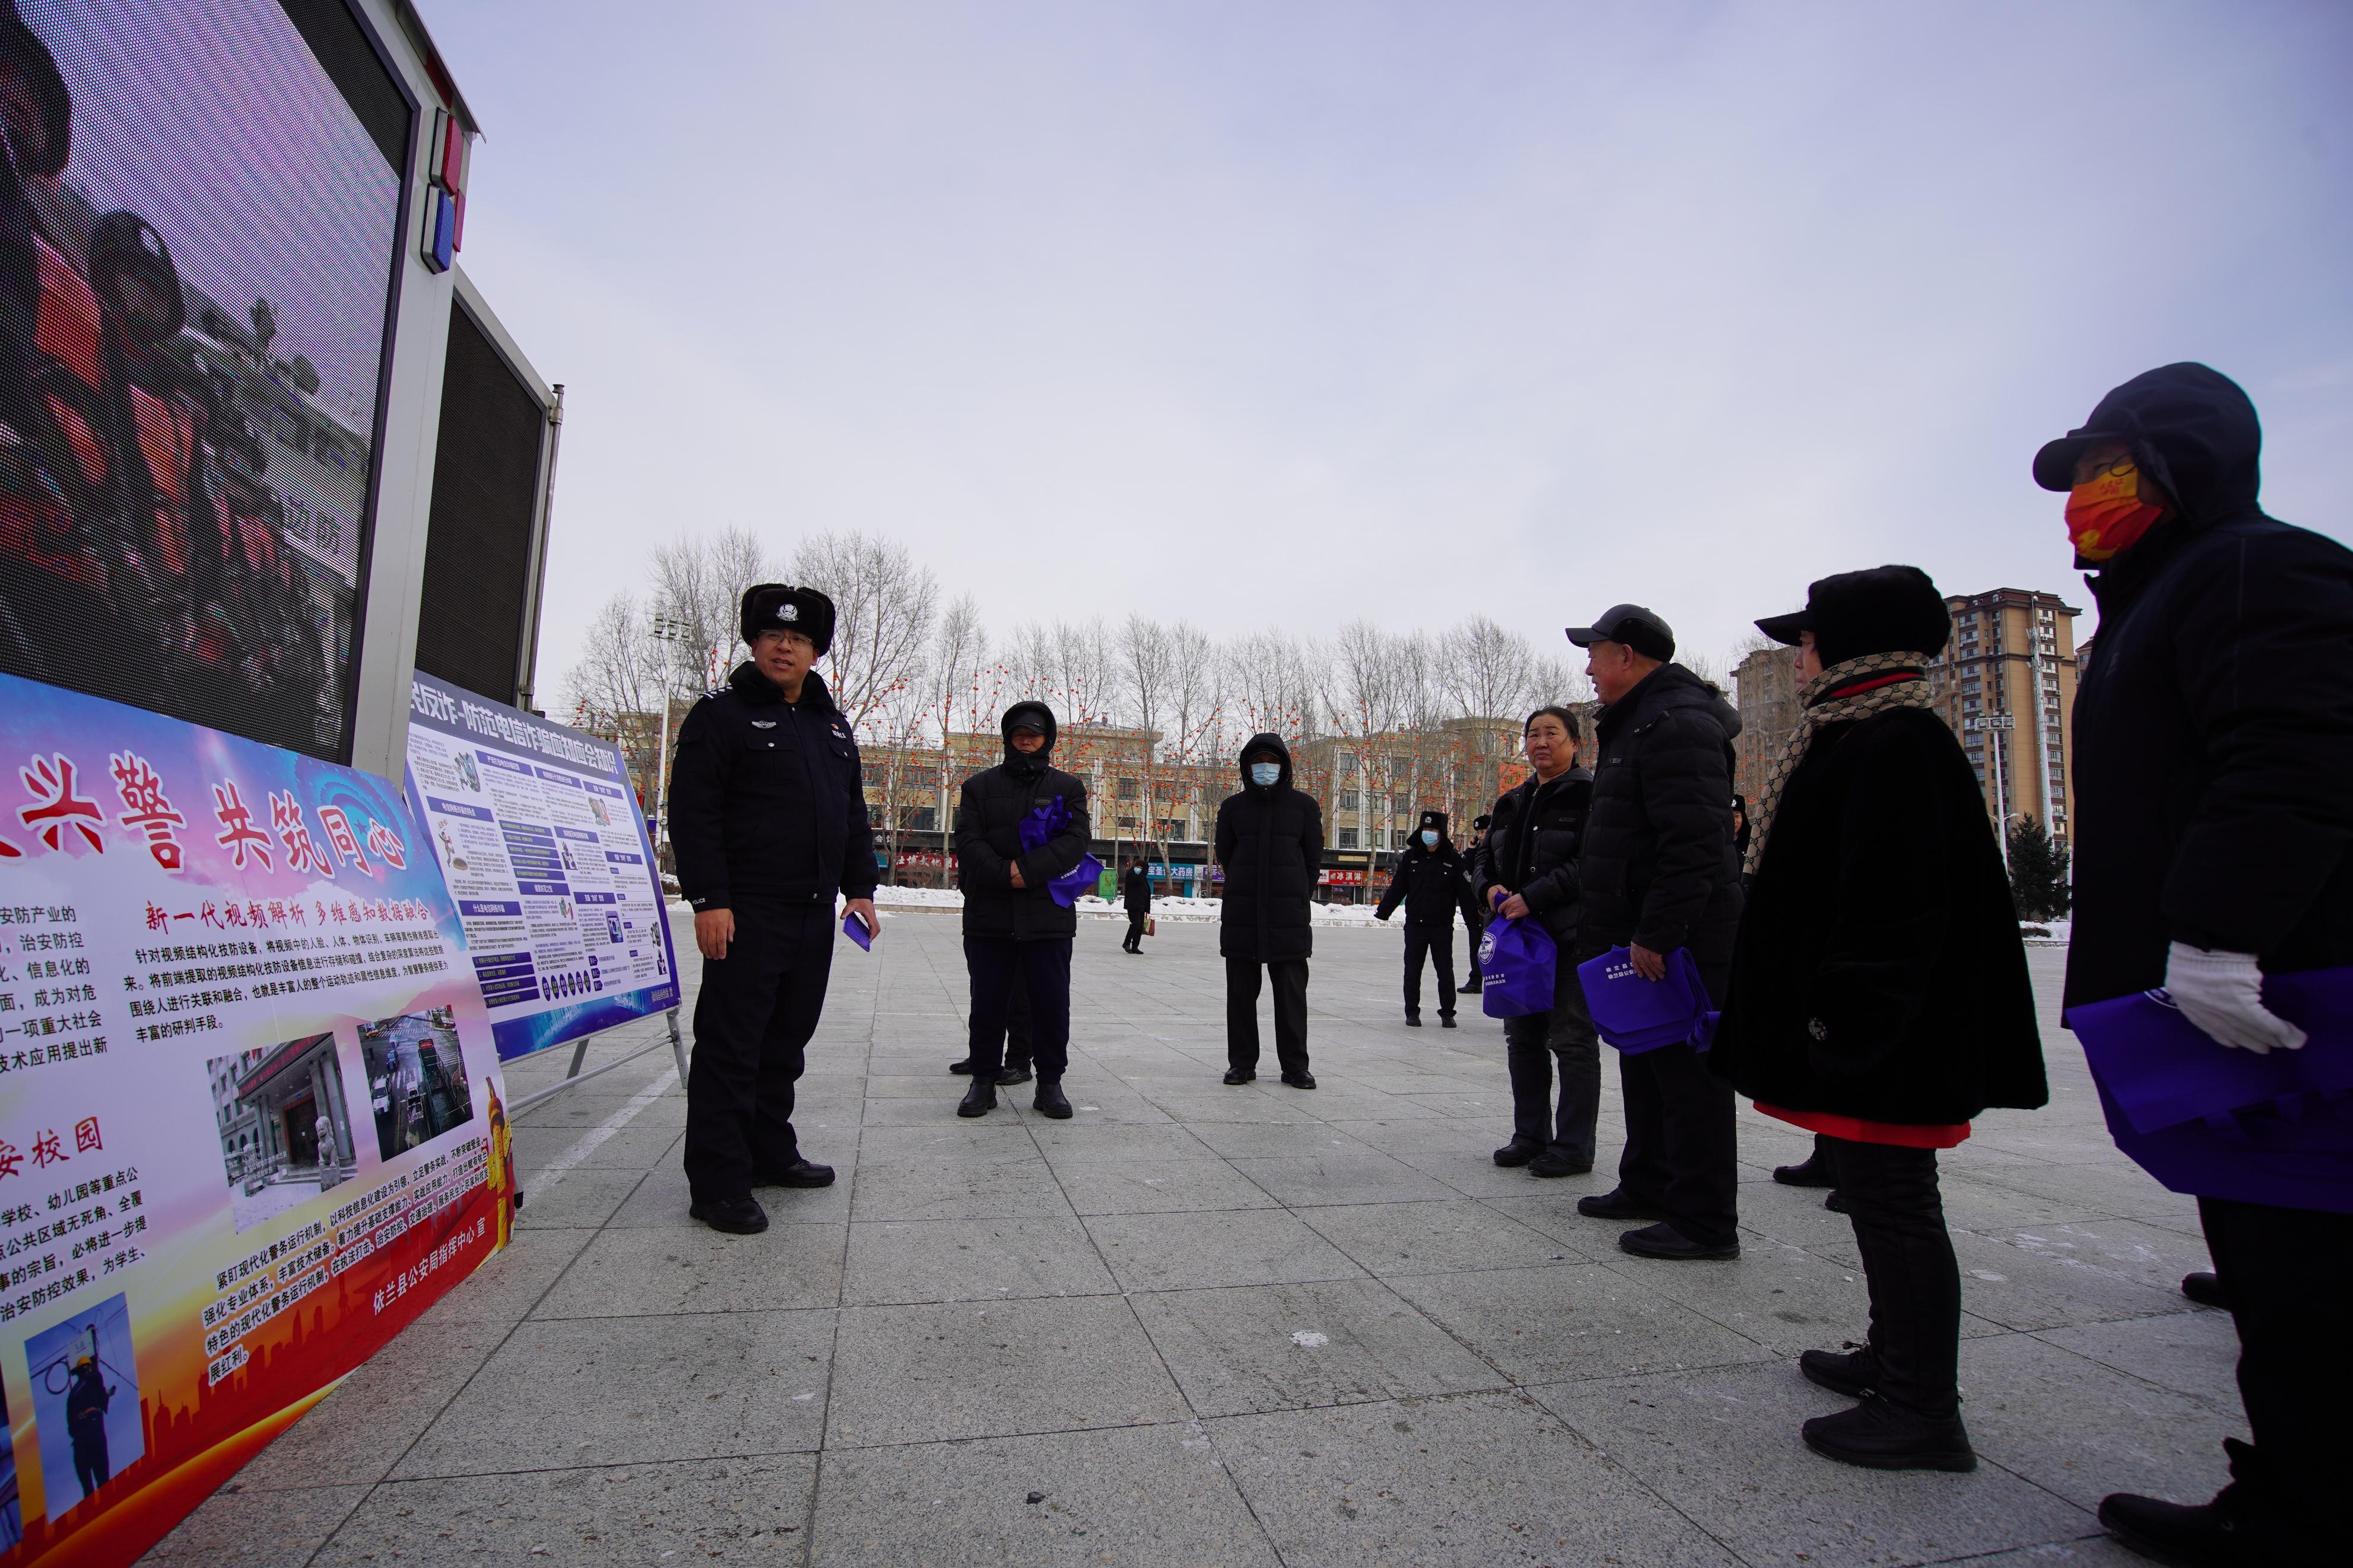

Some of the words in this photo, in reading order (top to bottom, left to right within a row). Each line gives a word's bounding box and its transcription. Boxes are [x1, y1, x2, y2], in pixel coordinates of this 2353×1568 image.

[0, 750, 186, 873] 兴警
[214, 777, 406, 879] 共筑同心
[1336, 872, 1361, 881] 冰淇淋
[0, 906, 77, 924] 安防产业的
[145, 899, 306, 935] 新一代视频解析
[315, 897, 430, 925] 多维感知数据融合
[0, 931, 84, 954] ，治安防控
[1608, 969, 1636, 979] 依兰县公安
[0, 984, 97, 1012] 面，成为对危
[0, 1010, 102, 1043] 一项重大社会
[135, 1015, 223, 1043] 丰富的研判手段。
[0, 1166, 138, 1227] 学校、幼儿园等重点公
[373, 1226, 474, 1316] 依兰县公安局指挥中心
[477, 1217, 485, 1238] 宣
[1, 1246, 145, 1322] 治安防控效果，为学生、
[209, 1347, 248, 1383] 展红利。
